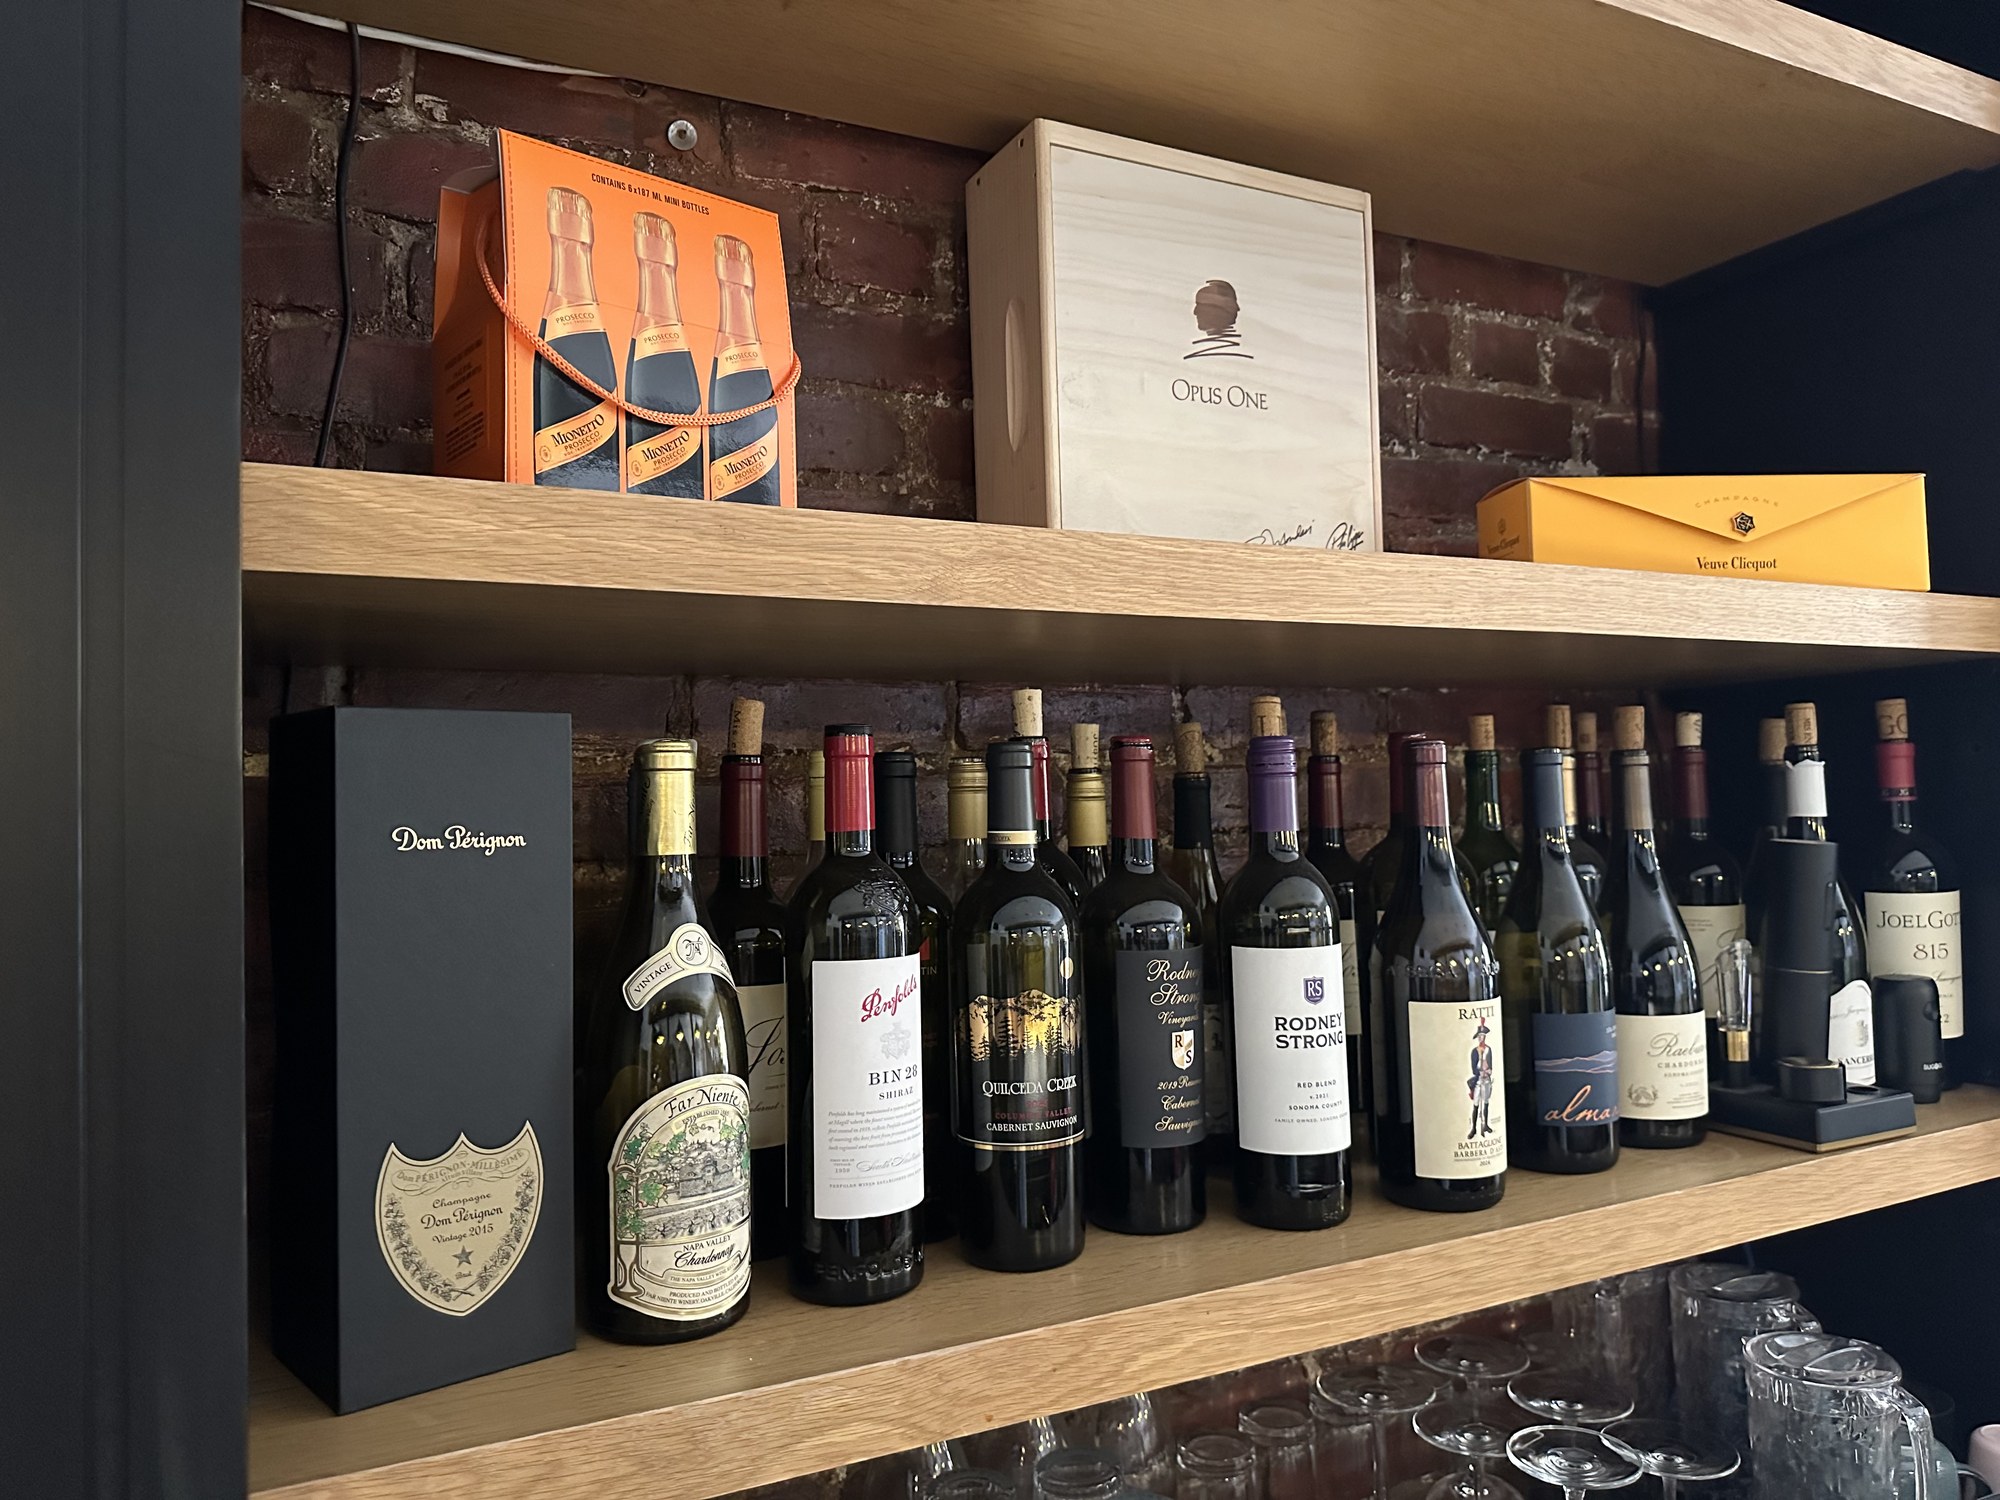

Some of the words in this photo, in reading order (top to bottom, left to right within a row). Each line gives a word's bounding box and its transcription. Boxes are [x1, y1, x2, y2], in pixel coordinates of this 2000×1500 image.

[591, 173, 626, 191] CONTAINS
[628, 184, 650, 198] 6x187
[652, 191, 662, 202] ML
[664, 195, 680, 206] MINI
[681, 200, 710, 215] BOTTLES
[555, 312, 595, 324] PROSECCO
[644, 332, 680, 344] PROSECCO
[725, 351, 758, 363] PROSECCO
[1172, 378, 1222, 404] OPUS
[1227, 385, 1269, 410] ONE
[551, 413, 605, 447] MIONETTO
[564, 430, 600, 451] PROSECCO
[641, 430, 690, 462] MIONETTO
[653, 446, 686, 466] PROSECCO
[723, 445, 768, 476] MIONETTO
[734, 461, 764, 480] PROSECCO
[1695, 495, 1779, 509] CHAMPAGNE
[1696, 556, 1728, 570] Veuve
[1731, 555, 1778, 572] Clicquot
[391, 826, 444, 851] Dom
[444, 825, 527, 856] Pérignon
[1913, 943, 1949, 960] 815
[634, 961, 673, 995] VINTAGE
[1308, 980, 1322, 997] RS
[860, 973, 918, 1023] Penfolds
[1458, 1006, 1494, 1020] RATTI
[1274, 1013, 1342, 1032] RODNEY
[1175, 1035, 1183, 1049] R
[1276, 1031, 1343, 1049] STRONG
[1186, 1050, 1192, 1064] S
[869, 1069, 901, 1086] BIN
[905, 1064, 918, 1080] 28
[1315, 1079, 1337, 1088] BLEND
[879, 1086, 914, 1100] SHIRAZ
[982, 1080, 1044, 1098] QUILCEDA
[1046, 1075, 1078, 1093] CREEK
[1157, 1081, 1178, 1090] 2019
[663, 1098, 694, 1119] Far
[696, 1086, 741, 1107] Niente
[986, 1123, 1033, 1132] CABERNET
[1035, 1115, 1078, 1130] SAUVIGNON
[1453, 1150, 1488, 1158] BARBERA
[432, 1193, 492, 1209] Champagne
[420, 1213, 452, 1230] Dom
[452, 1207, 503, 1224] Pérignon
[432, 1233, 467, 1244] Vintage
[469, 1223, 494, 1236] 2015
[683, 1243, 704, 1252] NAPA
[706, 1234, 731, 1247] VALLEY
[674, 1243, 736, 1269] Chardonnay
[645, 1291, 656, 1300] FAR
[669, 1291, 700, 1299] PRODUCED
[702, 1288, 714, 1297] AND
